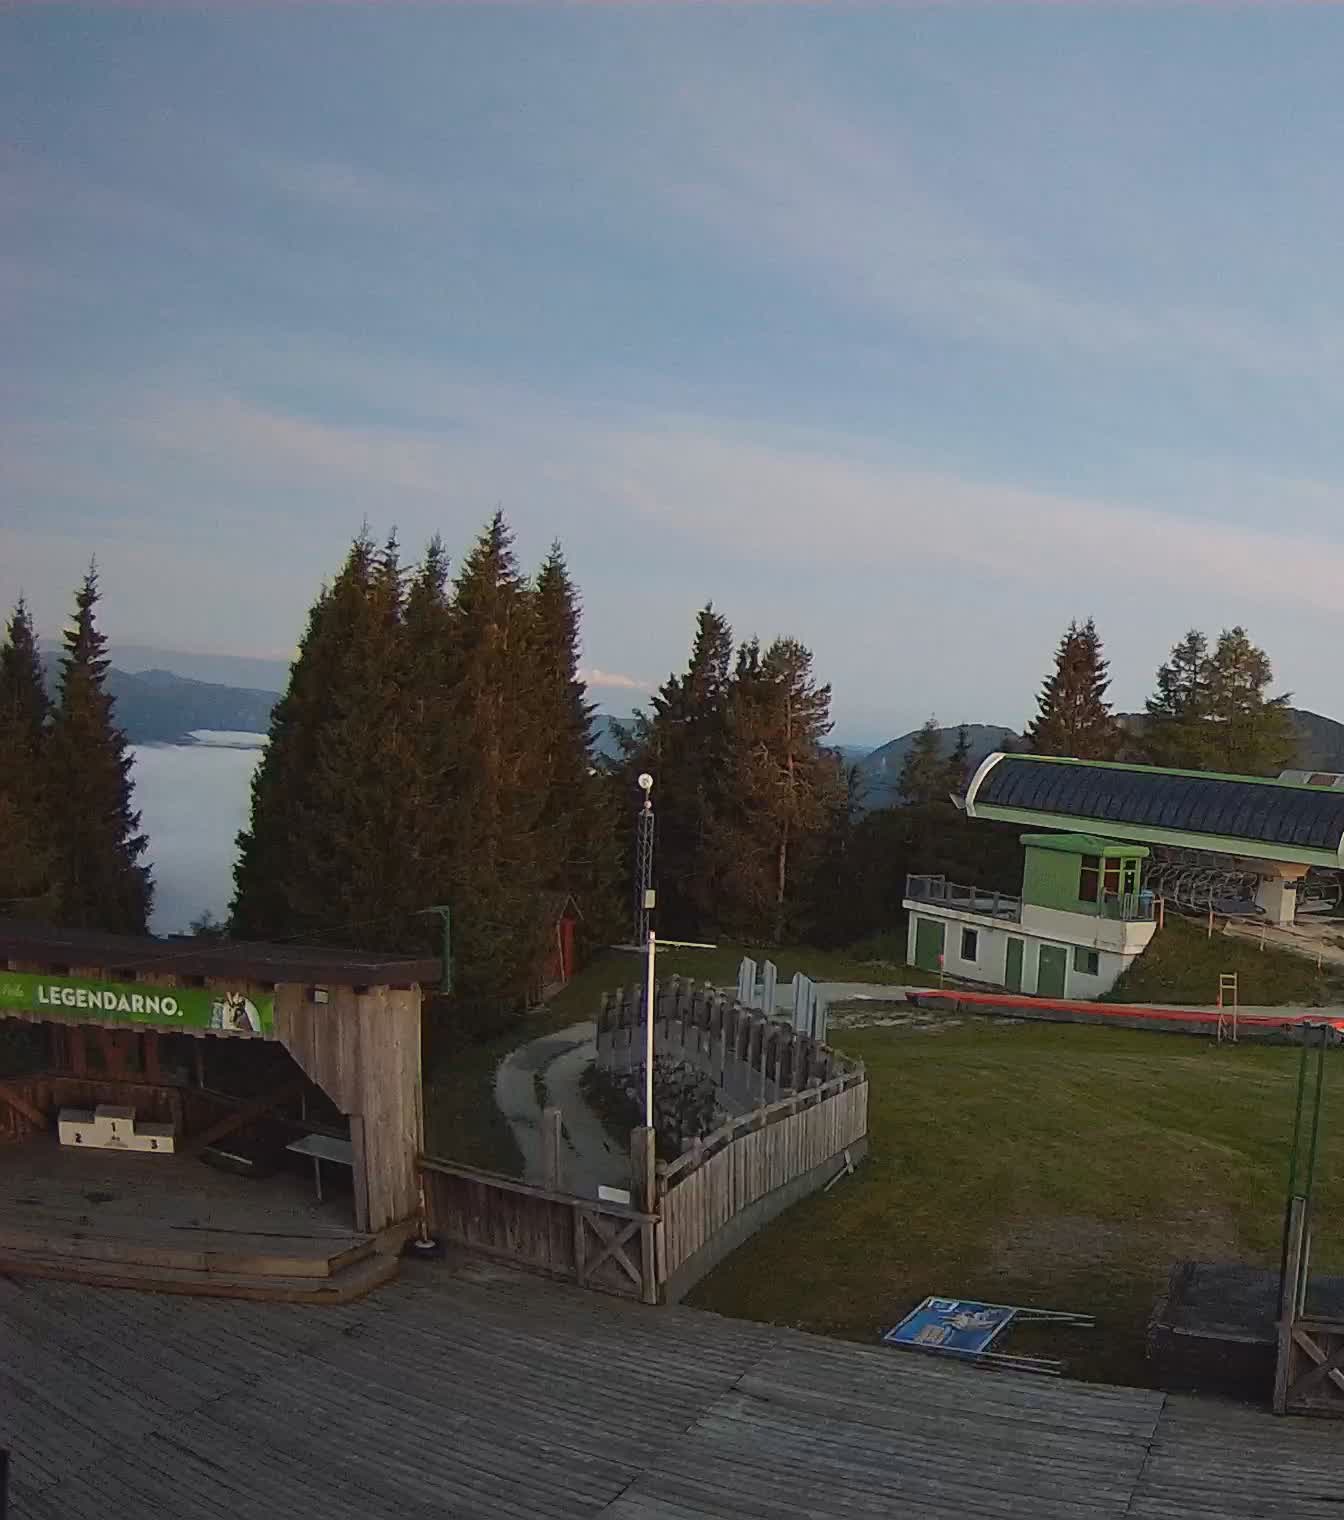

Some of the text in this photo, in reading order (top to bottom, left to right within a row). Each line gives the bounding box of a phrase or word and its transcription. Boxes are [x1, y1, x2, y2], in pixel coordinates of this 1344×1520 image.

[37, 984, 184, 1017] LEGENDARNO.
[75, 1133, 82, 1143] 2
[151, 1139, 158, 1149] 3
